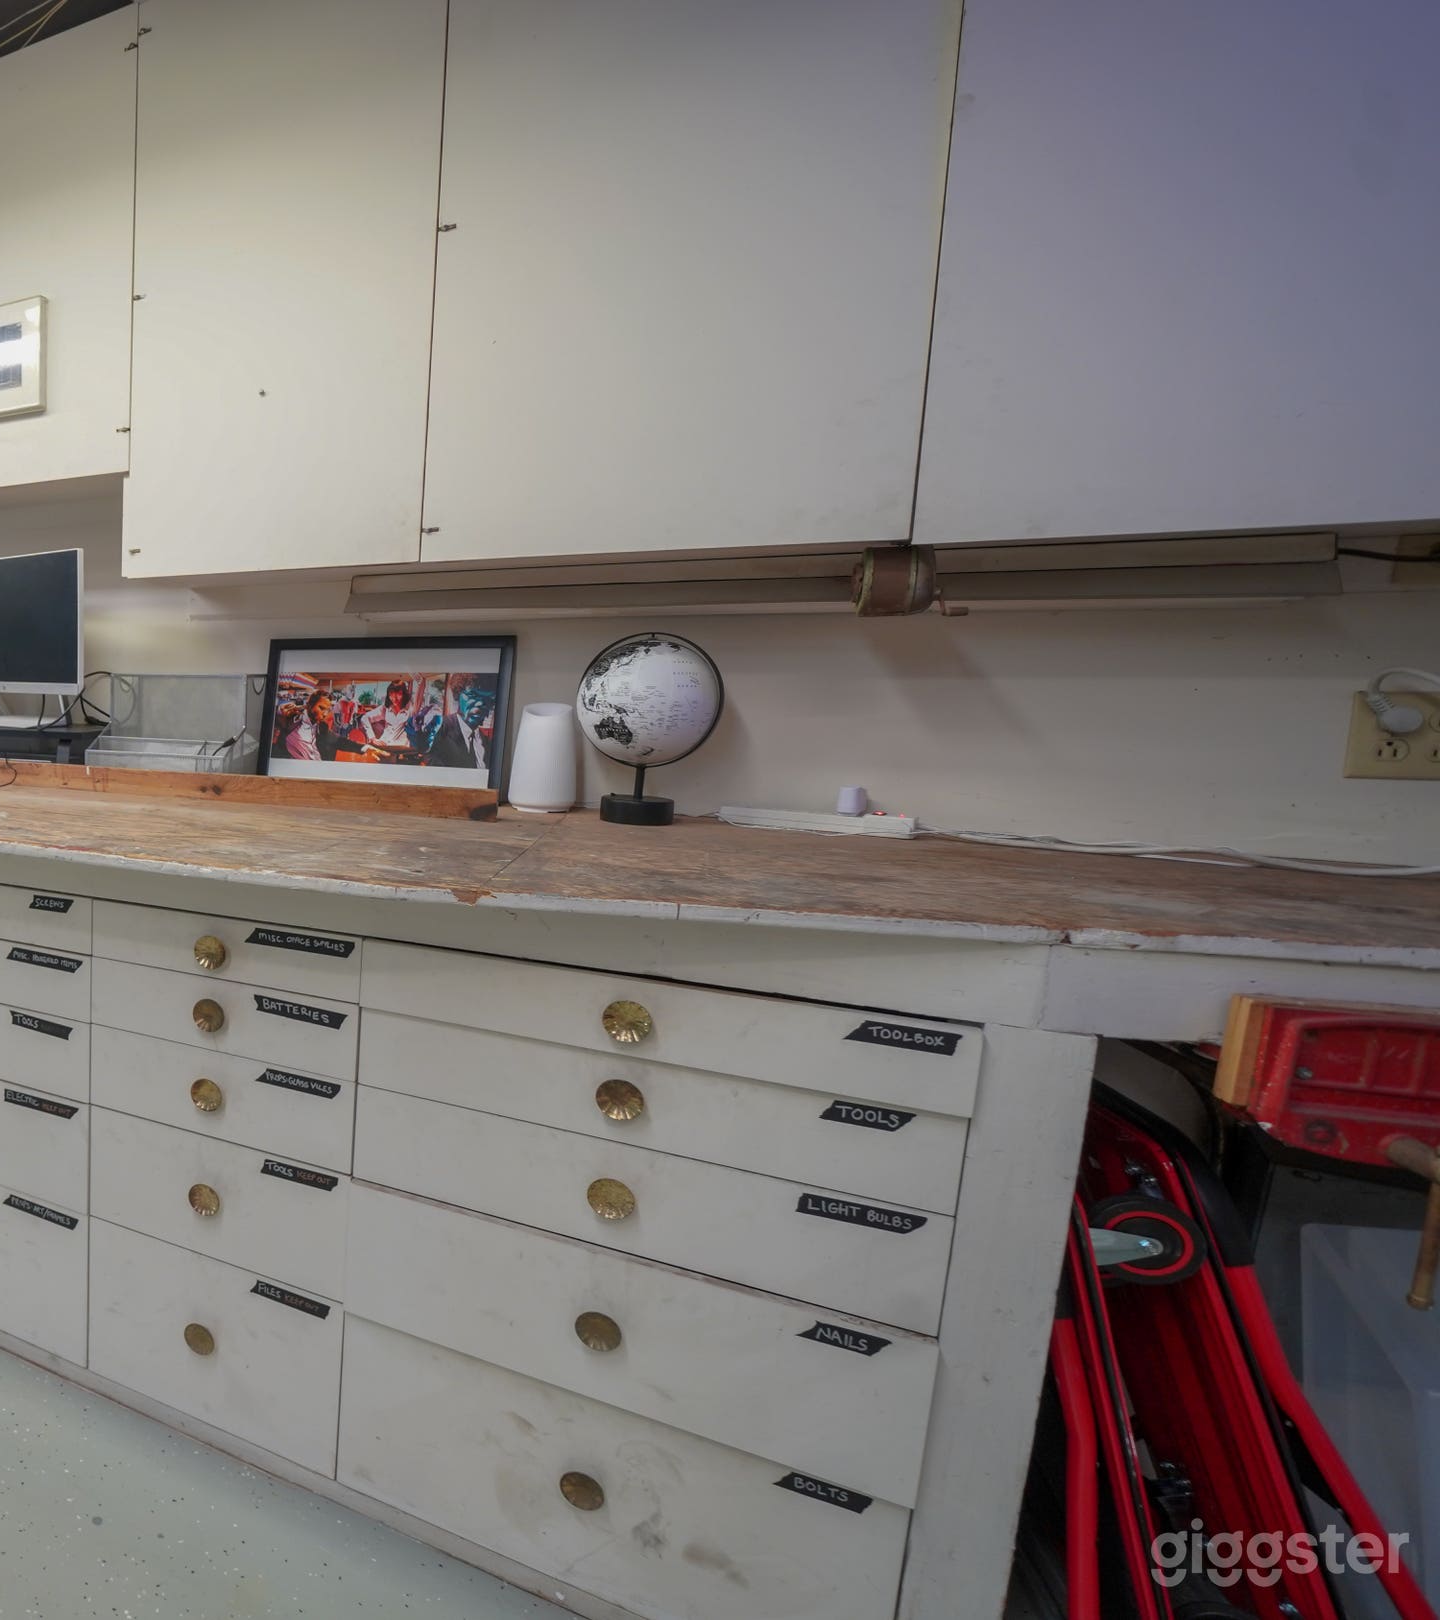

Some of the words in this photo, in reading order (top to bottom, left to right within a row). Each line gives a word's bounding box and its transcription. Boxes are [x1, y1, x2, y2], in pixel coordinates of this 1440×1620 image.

[258, 932, 284, 943] MISC.
[14, 1014, 40, 1029] TOOLS
[262, 998, 330, 1024] BATTERIES
[867, 1025, 945, 1047] TOOLBOX
[835, 1105, 900, 1129] TOOLS
[265, 1162, 294, 1177] TOOLS
[807, 1198, 862, 1217] LIGHT
[866, 1209, 913, 1229] BULBS
[257, 1283, 281, 1298] FILES
[815, 1327, 869, 1352] NAILS
[793, 1476, 849, 1503] BOLTS
